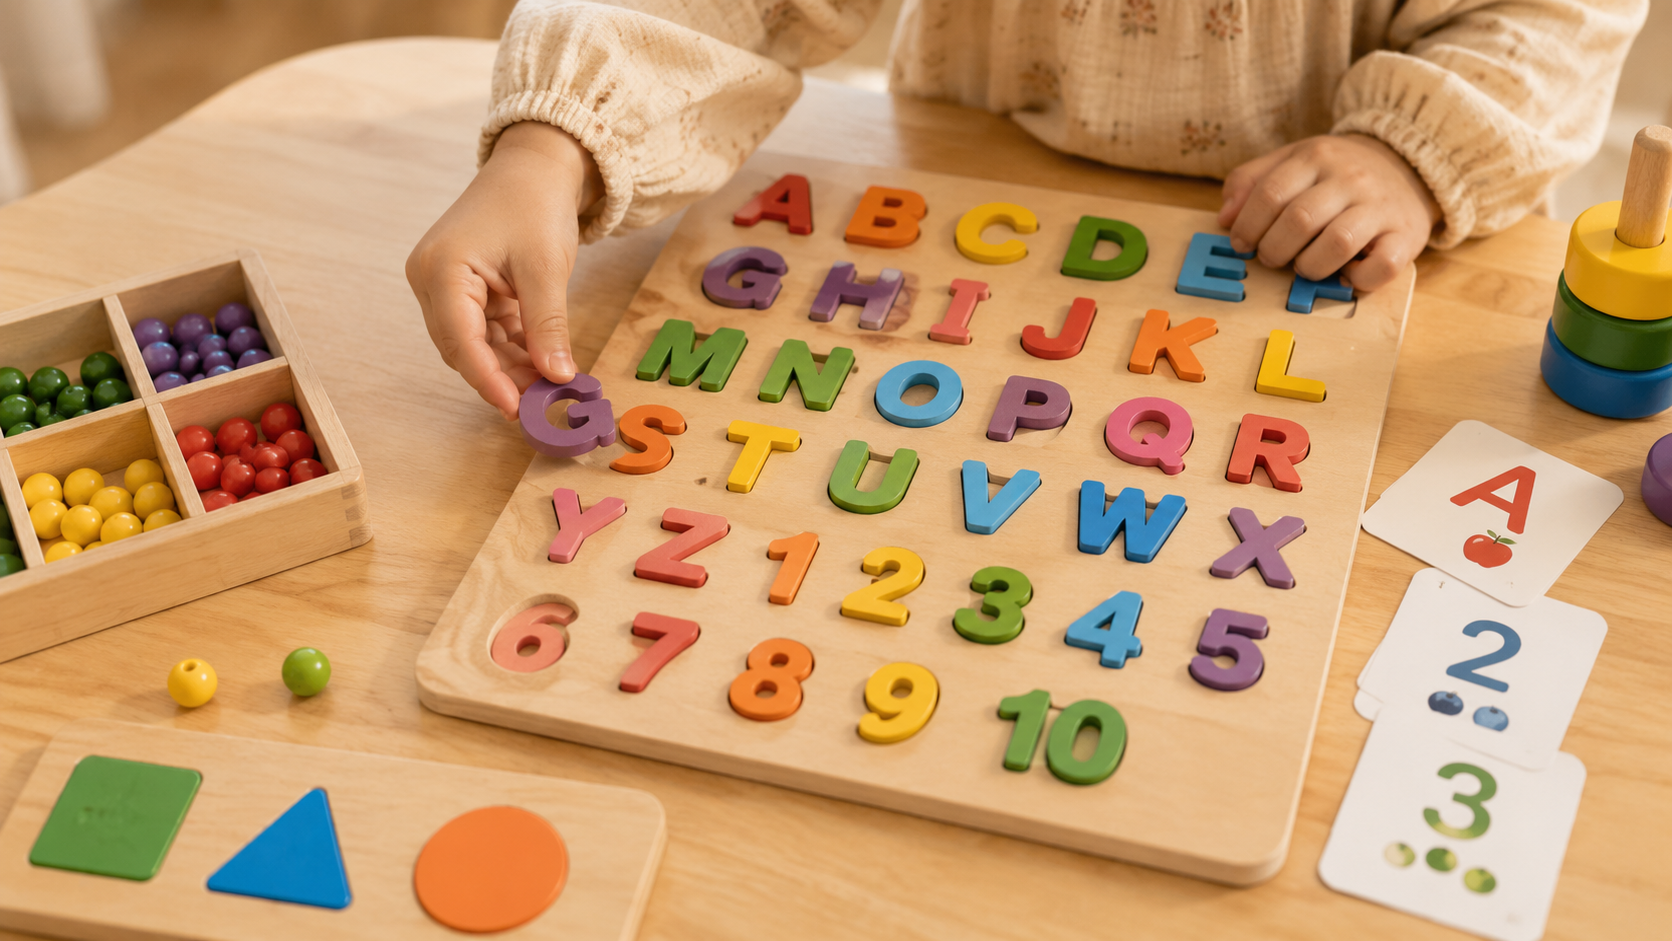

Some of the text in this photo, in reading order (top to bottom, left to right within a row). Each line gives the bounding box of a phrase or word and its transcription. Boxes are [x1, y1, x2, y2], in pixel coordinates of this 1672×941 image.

[733, 174, 814, 235] A
[844, 185, 927, 248] B
[955, 202, 1039, 265] C
[1061, 215, 1149, 281] D
[1176, 232, 1256, 301] E
[702, 246, 1327, 402] G H I J K L
[519, 373, 616, 458] G
[636, 319, 1312, 493] M N O P Q R
[609, 404, 1307, 590] S T U V W X
[1449, 465, 1537, 535] A
[548, 488, 1270, 691] Y Z 1 2 3 4 5
[1446, 619, 1522, 693] 2
[490, 602, 1128, 786] 6 7 8 9 10
[1422, 762, 1498, 840] 3
